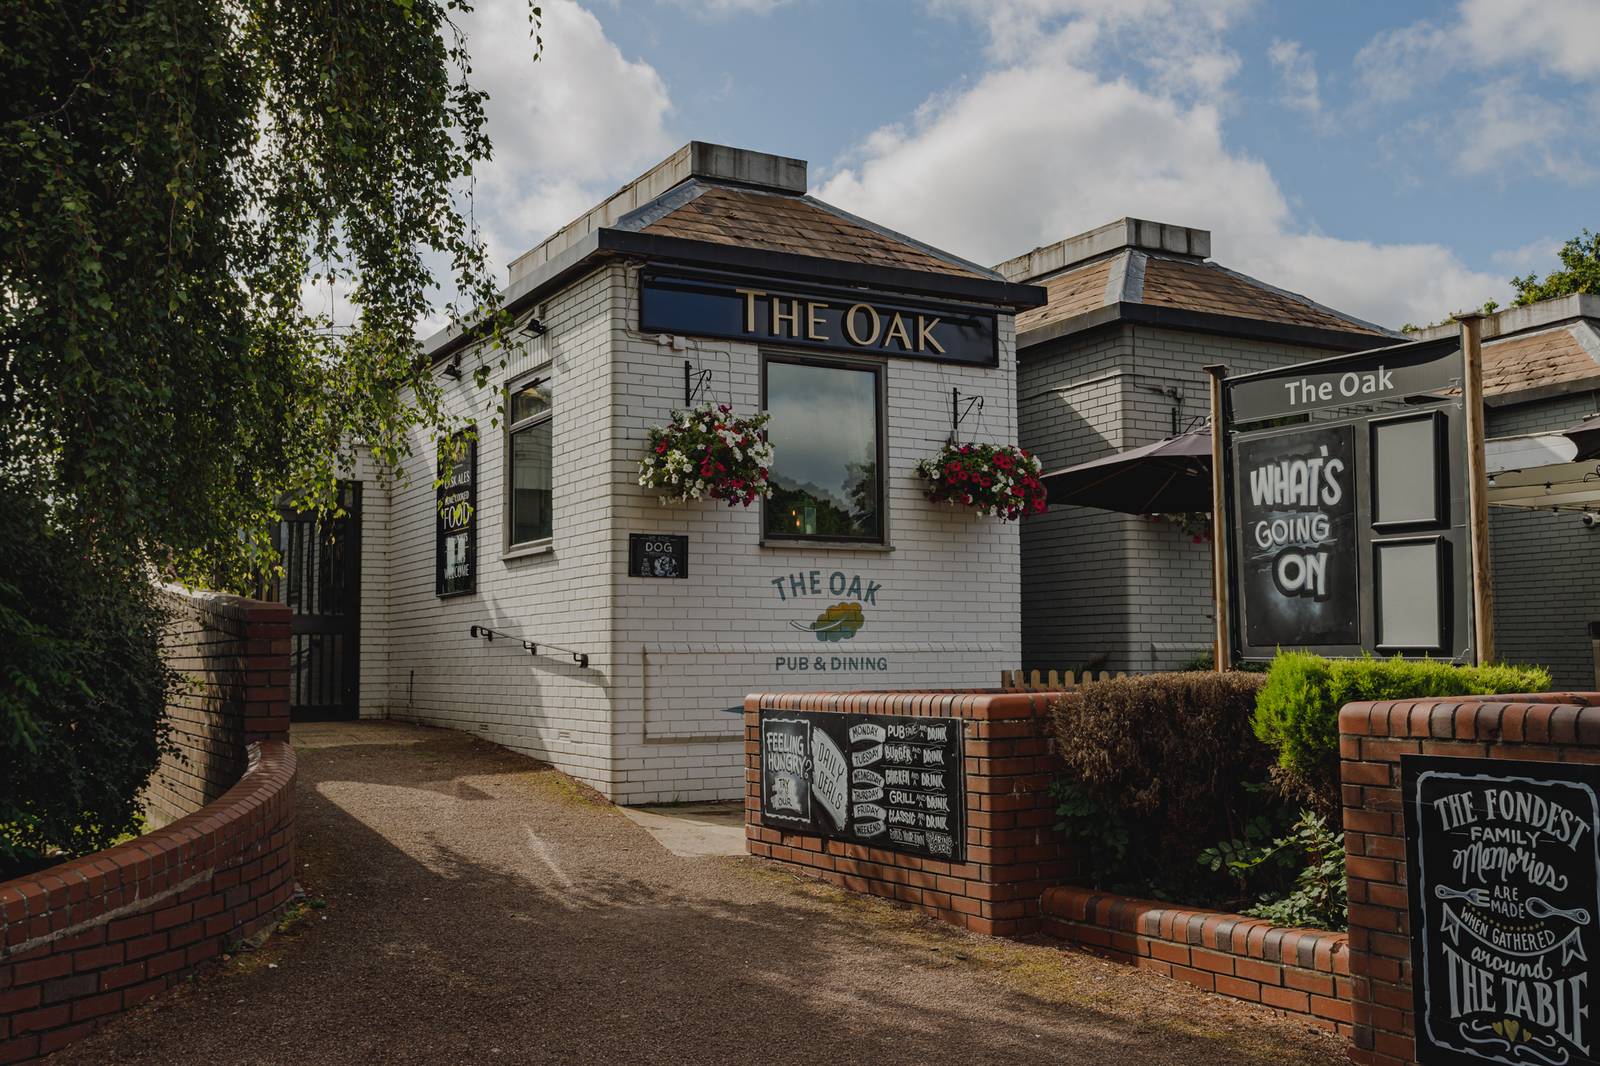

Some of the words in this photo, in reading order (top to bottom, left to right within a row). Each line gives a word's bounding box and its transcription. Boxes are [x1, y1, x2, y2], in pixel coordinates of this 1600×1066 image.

[735, 288, 830, 341] THE
[845, 303, 946, 354] OAK
[1284, 378, 1333, 405] The
[1339, 365, 1394, 397] Oak
[1250, 445, 1345, 506] WHAT'S
[444, 502, 470, 529] FOOD
[1255, 514, 1330, 548] GOING
[645, 542, 673, 553] DOG
[1278, 552, 1329, 596] ON
[771, 570, 822, 602] THE
[829, 571, 882, 607] OAK
[775, 656, 809, 671] PUB
[813, 656, 827, 672] &
[830, 656, 888, 672] DINING
[852, 725, 879, 739] MONDAY
[887, 725, 905, 739] PUB
[927, 726, 947, 742] DRINK
[766, 732, 805, 757] FEELING
[884, 745, 913, 762] BURGER
[923, 749, 945, 765] DRINK
[818, 743, 845, 783] DAILY
[854, 748, 880, 765] TUESDAY
[853, 770, 881, 785] WEDNESDAY
[921, 772, 946, 789] DRINK
[817, 771, 843, 810] DEALS
[853, 789, 879, 801] THURSDAY
[889, 790, 916, 805] GRILL
[926, 795, 950, 812] DRINK
[778, 797, 793, 807] OUR
[856, 804, 880, 816] FRIDAY
[856, 821, 881, 835] WEEKEND
[926, 814, 949, 830] DRINK
[1433, 791, 1478, 832] THE
[1484, 789, 1591, 852] FONDEST
[1471, 826, 1541, 849] FAMILY
[1452, 841, 1568, 892] Memories
[1494, 885, 1519, 901] ARE
[1490, 900, 1526, 919] MADE
[1460, 906, 1489, 938] WHEN
[1492, 928, 1556, 951] GATHERED
[1471, 946, 1553, 981] around
[1442, 942, 1497, 1019] THE
[1501, 971, 1591, 1057] TABLE
